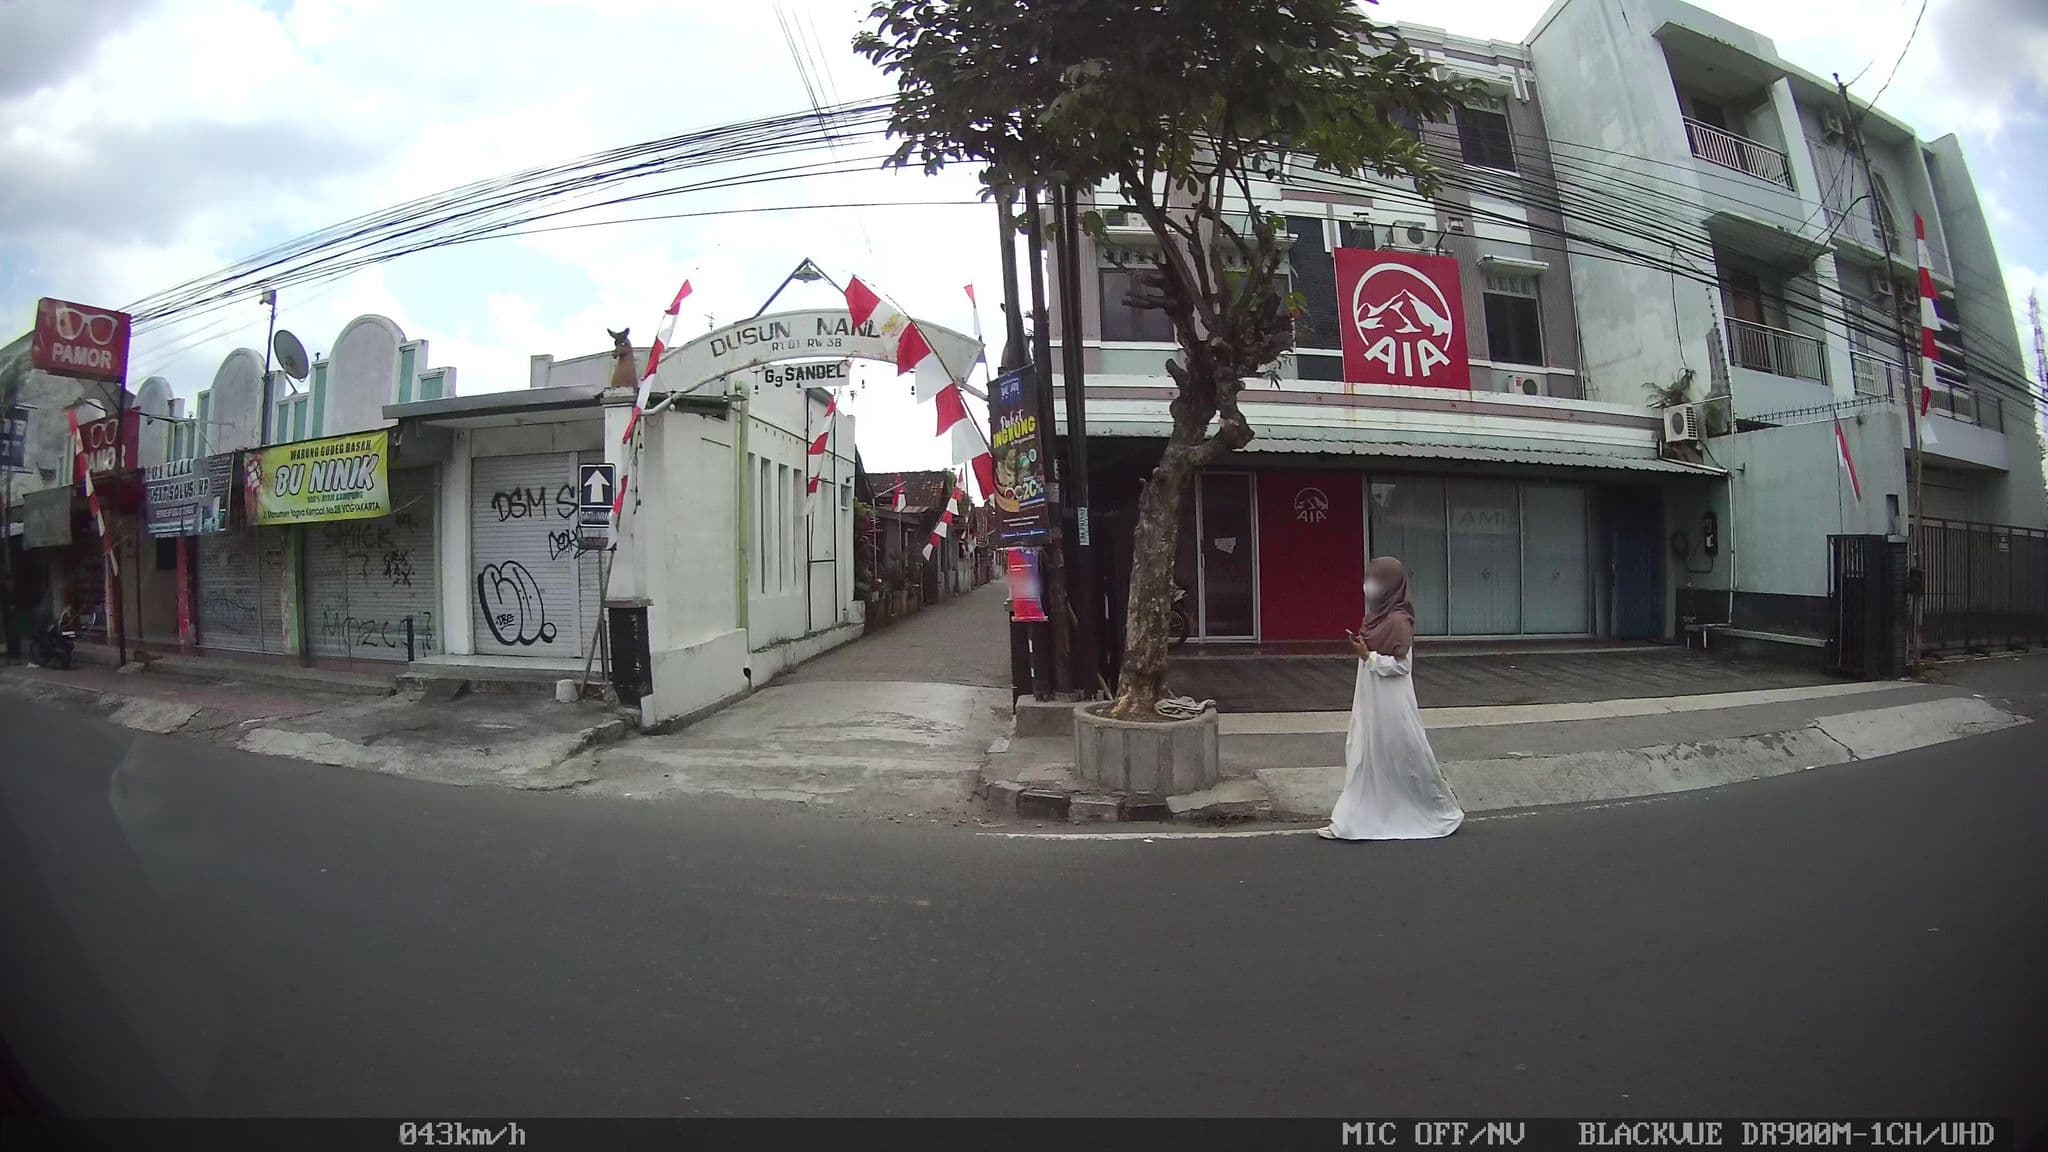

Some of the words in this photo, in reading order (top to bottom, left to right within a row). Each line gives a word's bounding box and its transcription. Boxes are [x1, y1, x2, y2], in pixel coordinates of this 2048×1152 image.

[710, 321, 791, 358] DUSUN
[807, 338, 823, 348] RW
[52, 342, 113, 370] PAMOR
[1363, 336, 1450, 377] AIA
[765, 369, 784, 388] Gg
[785, 364, 846, 382] SANDEL
[290, 446, 319, 461] WARUNG
[319, 444, 344, 457] GUDEG
[275, 464, 305, 497] BU
[308, 453, 379, 494] NINIK
[491, 486, 547, 522] DSM
[1296, 509, 1327, 523] AIA
